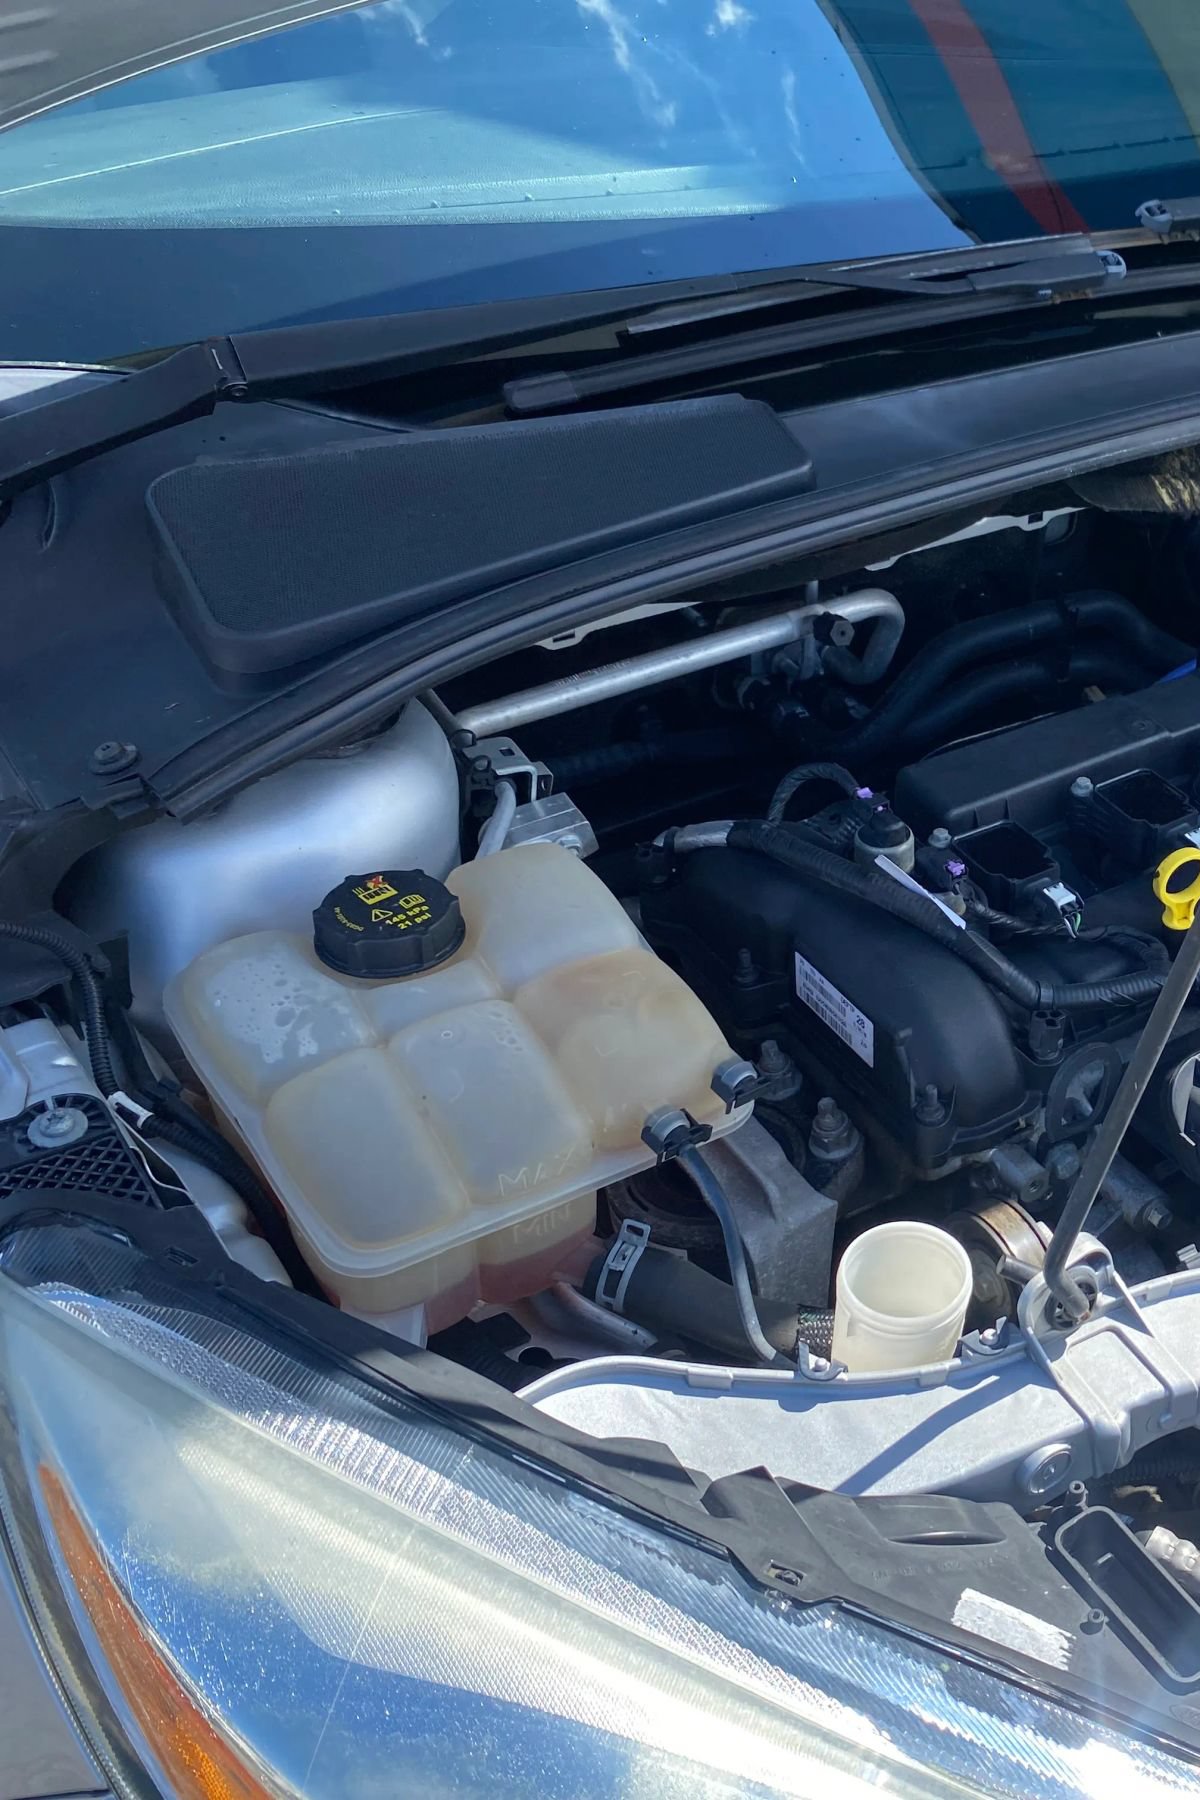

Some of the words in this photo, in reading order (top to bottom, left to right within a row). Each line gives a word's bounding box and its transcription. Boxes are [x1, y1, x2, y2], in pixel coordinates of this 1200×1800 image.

[385, 913, 406, 925] 145
[406, 905, 429, 916] kPa
[398, 920, 412, 930] 21
[415, 912, 432, 924] psi
[498, 1141, 578, 1197] MAX
